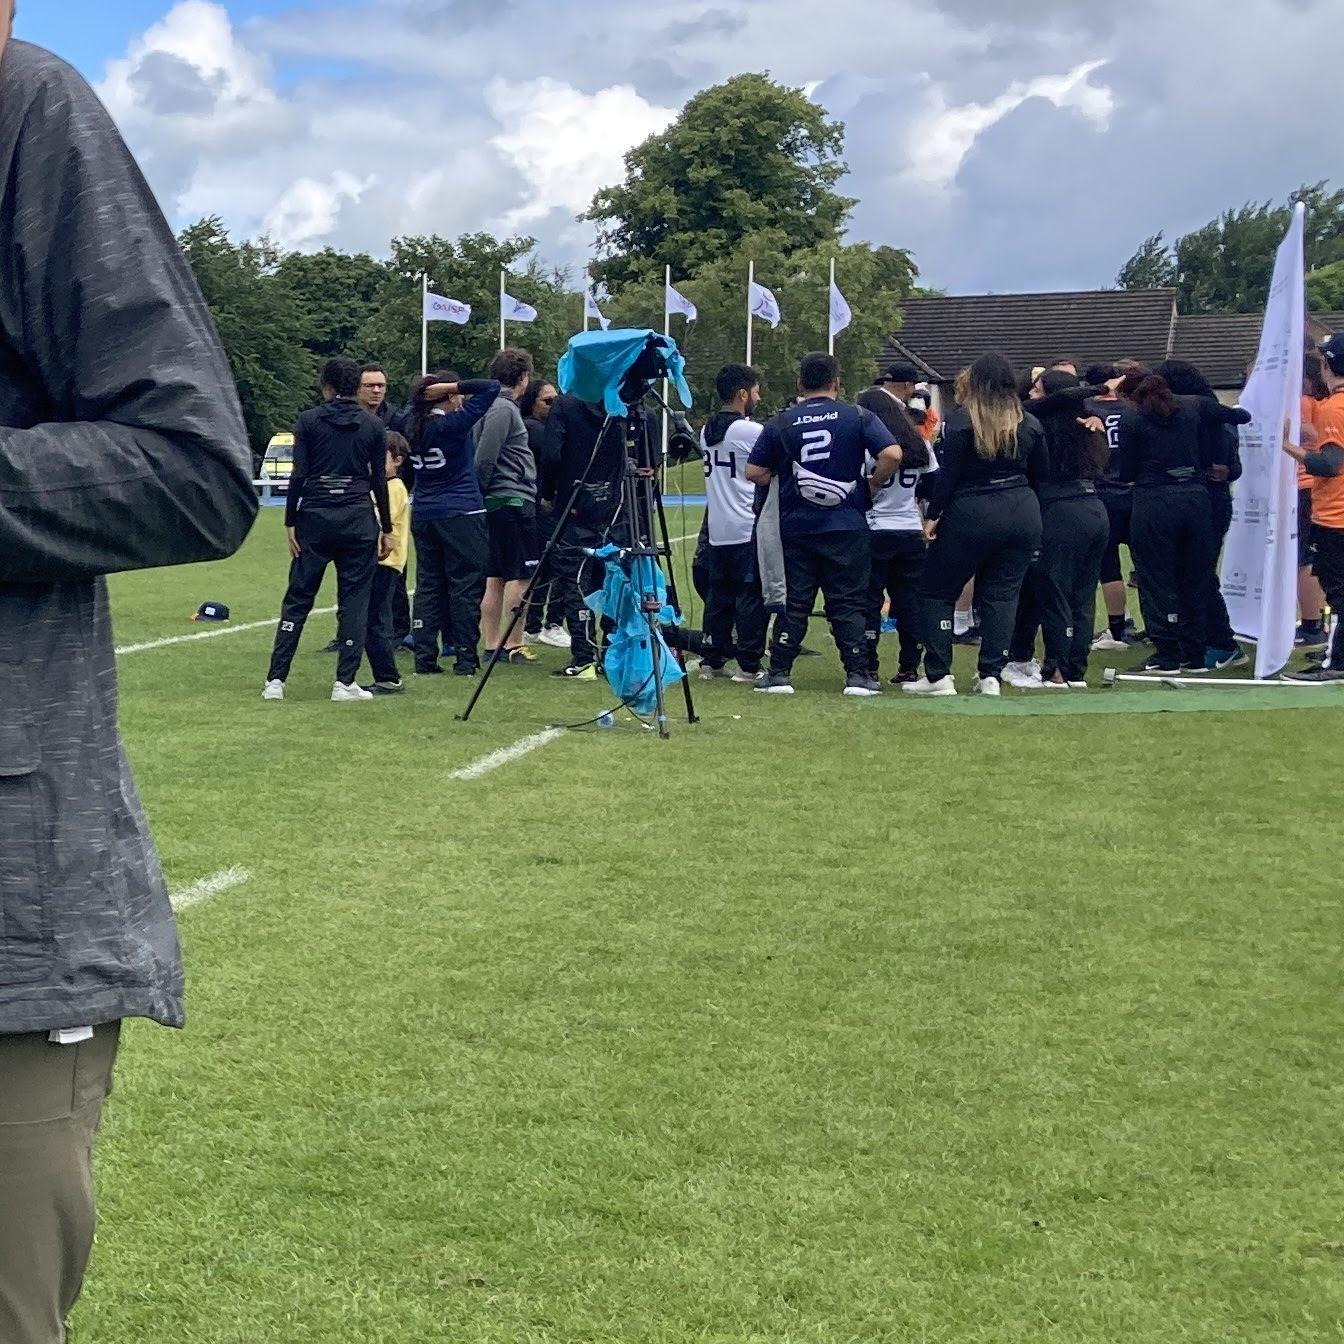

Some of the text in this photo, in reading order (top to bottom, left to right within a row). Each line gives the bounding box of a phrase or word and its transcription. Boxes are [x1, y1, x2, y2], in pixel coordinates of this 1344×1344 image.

[792, 411, 839, 426] J.David
[800, 429, 832, 463] 2
[779, 632, 789, 645] 2
